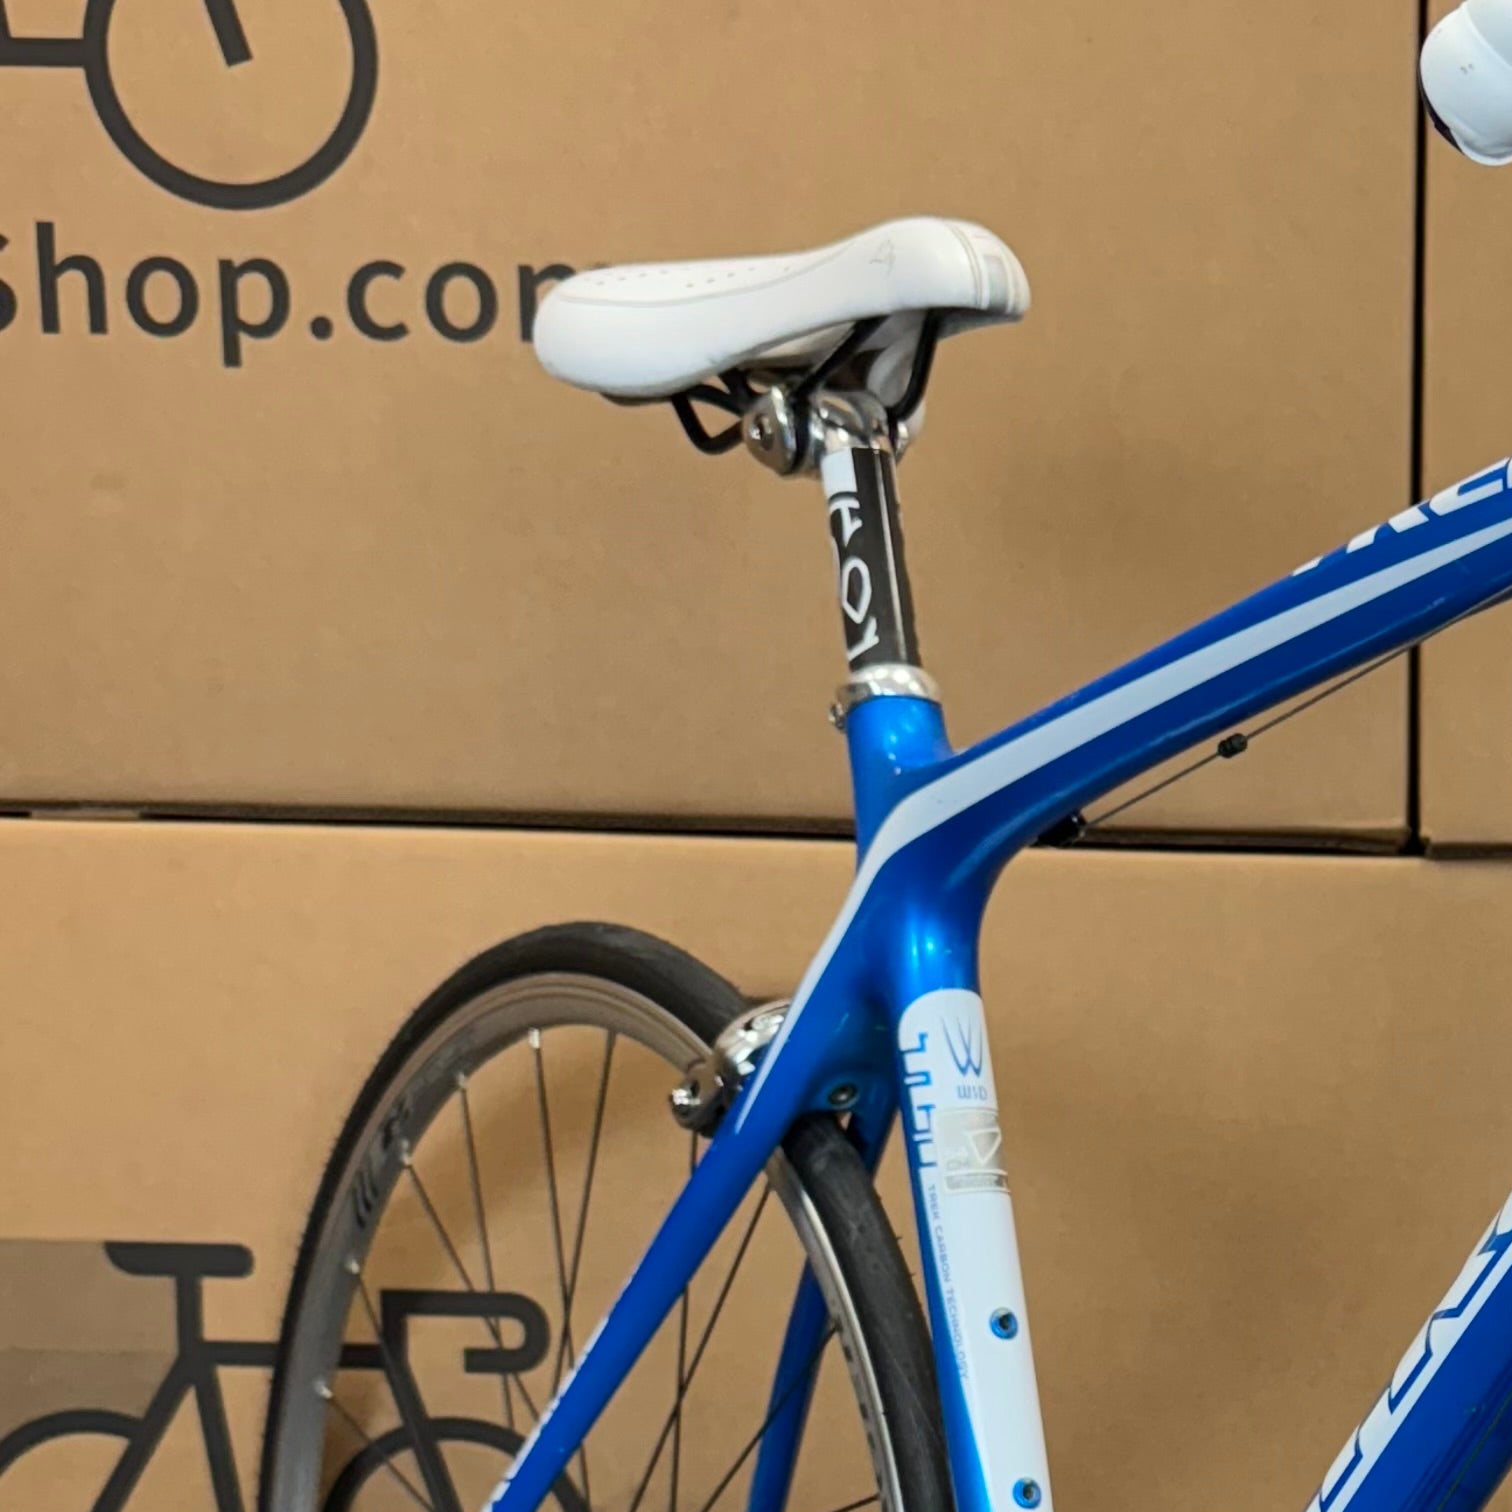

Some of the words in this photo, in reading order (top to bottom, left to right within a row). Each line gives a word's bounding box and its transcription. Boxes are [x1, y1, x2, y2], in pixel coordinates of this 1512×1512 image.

[928, 1183, 940, 1220] TREK
[935, 1225, 951, 1283] CARBON
[946, 1286, 970, 1381] TECHNOLOGY
